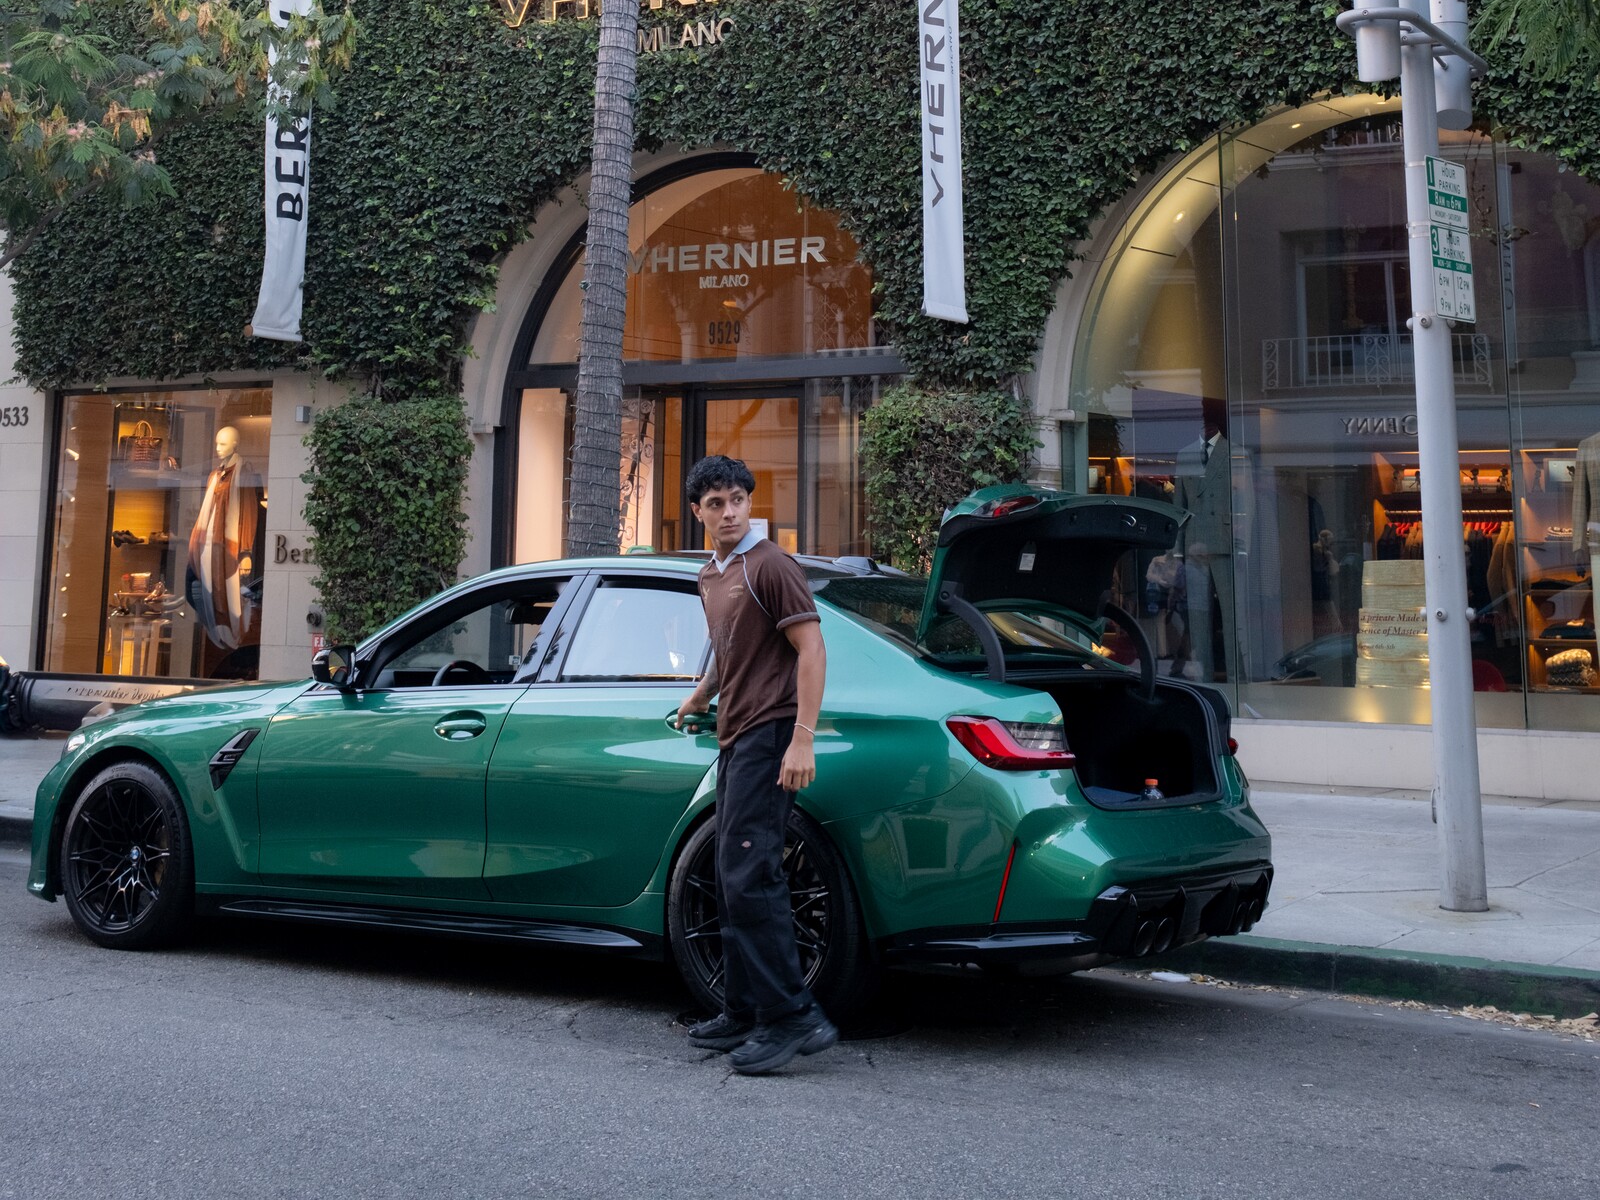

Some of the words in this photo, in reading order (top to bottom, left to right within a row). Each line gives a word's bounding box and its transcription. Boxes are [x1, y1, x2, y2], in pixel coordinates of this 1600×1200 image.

[638, 17, 737, 54] MILANO
[1428, 161, 1433, 184] 1
[1442, 167, 1456, 179] HOUR
[1439, 179, 1461, 194] PARKING
[1431, 228, 1439, 252] 3
[1446, 233, 1460, 246] HOUR
[627, 236, 828, 274] VHERNIER
[1443, 247, 1465, 261] PARKING
[699, 273, 749, 289] MILANO
[709, 321, 740, 345] 9529
[273, 533, 317, 565] Ber
[1367, 613, 1395, 623] private
[1396, 613, 1420, 622] Made
[1382, 627, 1393, 637] of
[1393, 627, 1420, 636] Master
